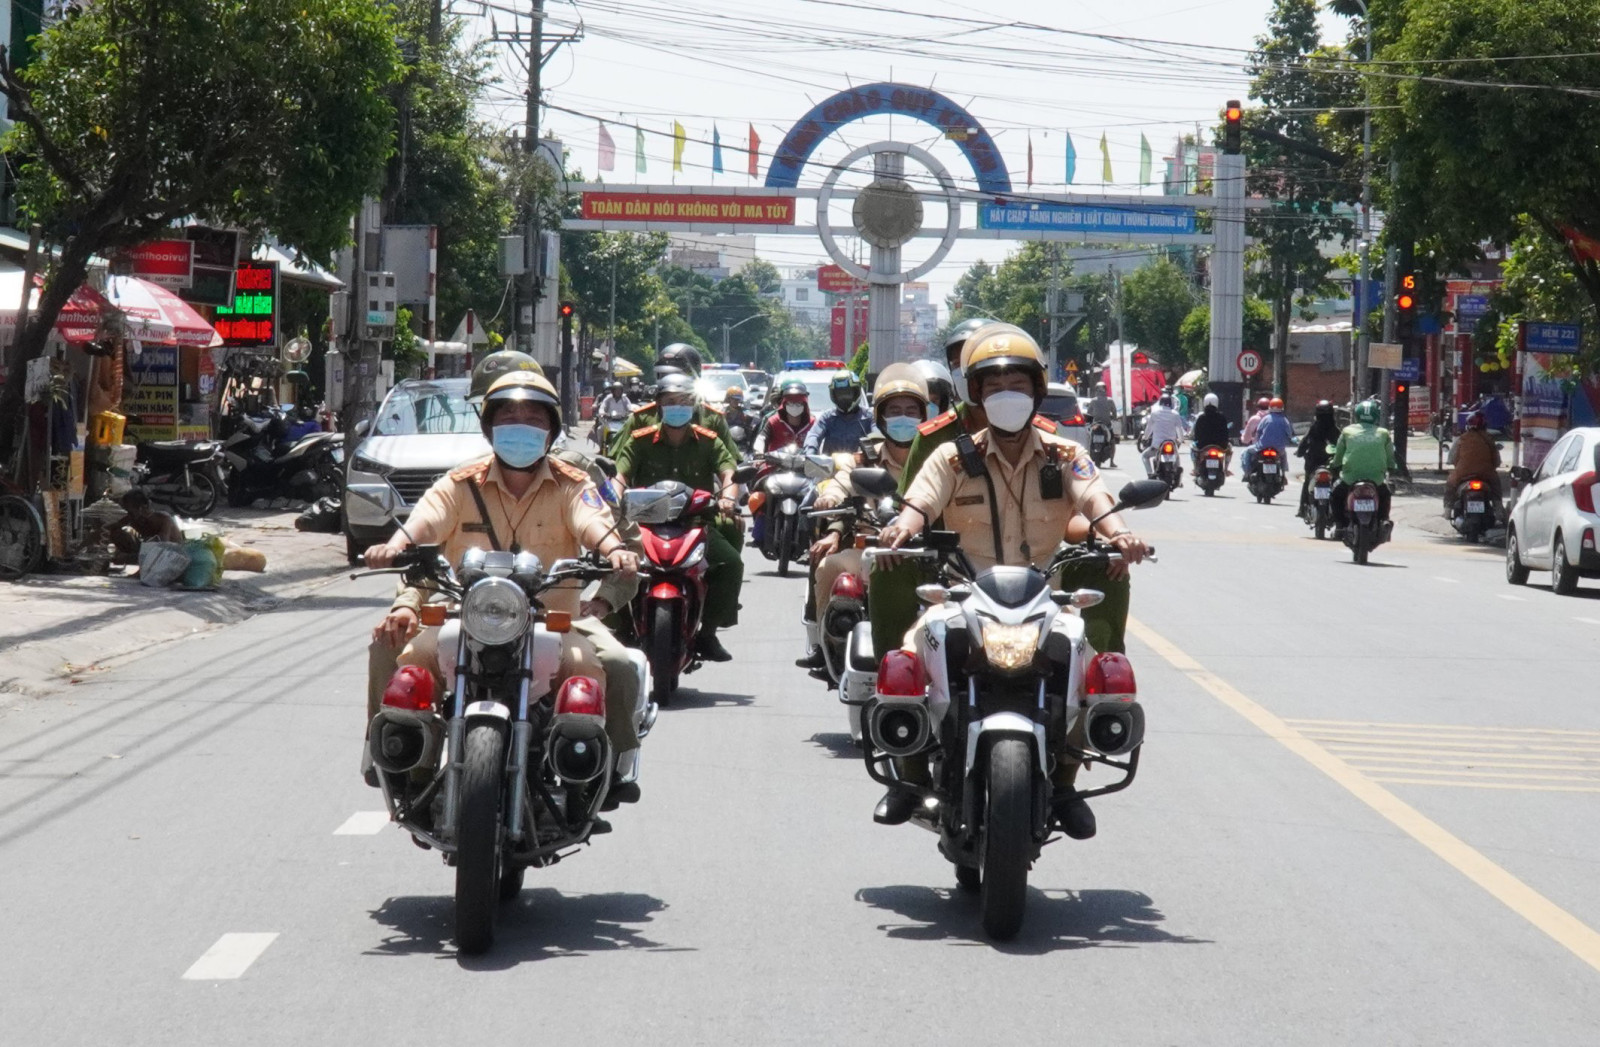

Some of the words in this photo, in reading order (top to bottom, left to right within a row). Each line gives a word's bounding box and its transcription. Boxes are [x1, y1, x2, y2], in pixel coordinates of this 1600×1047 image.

[591, 200, 623, 214] TOÀN
[625, 199, 650, 215] DÂN
[653, 200, 675, 216] NÓI
[677, 200, 719, 217] KHÔNG
[722, 201, 741, 218] VỚI
[744, 204, 763, 218] MA
[766, 202, 788, 219] TÚY
[1103, 212, 1121, 225] GIAO
[122, 249, 188, 262] ienthoaivui
[1404, 276, 1414, 288] 15
[1561, 329, 1575, 339] 221
[155, 390, 174, 401] PIN
